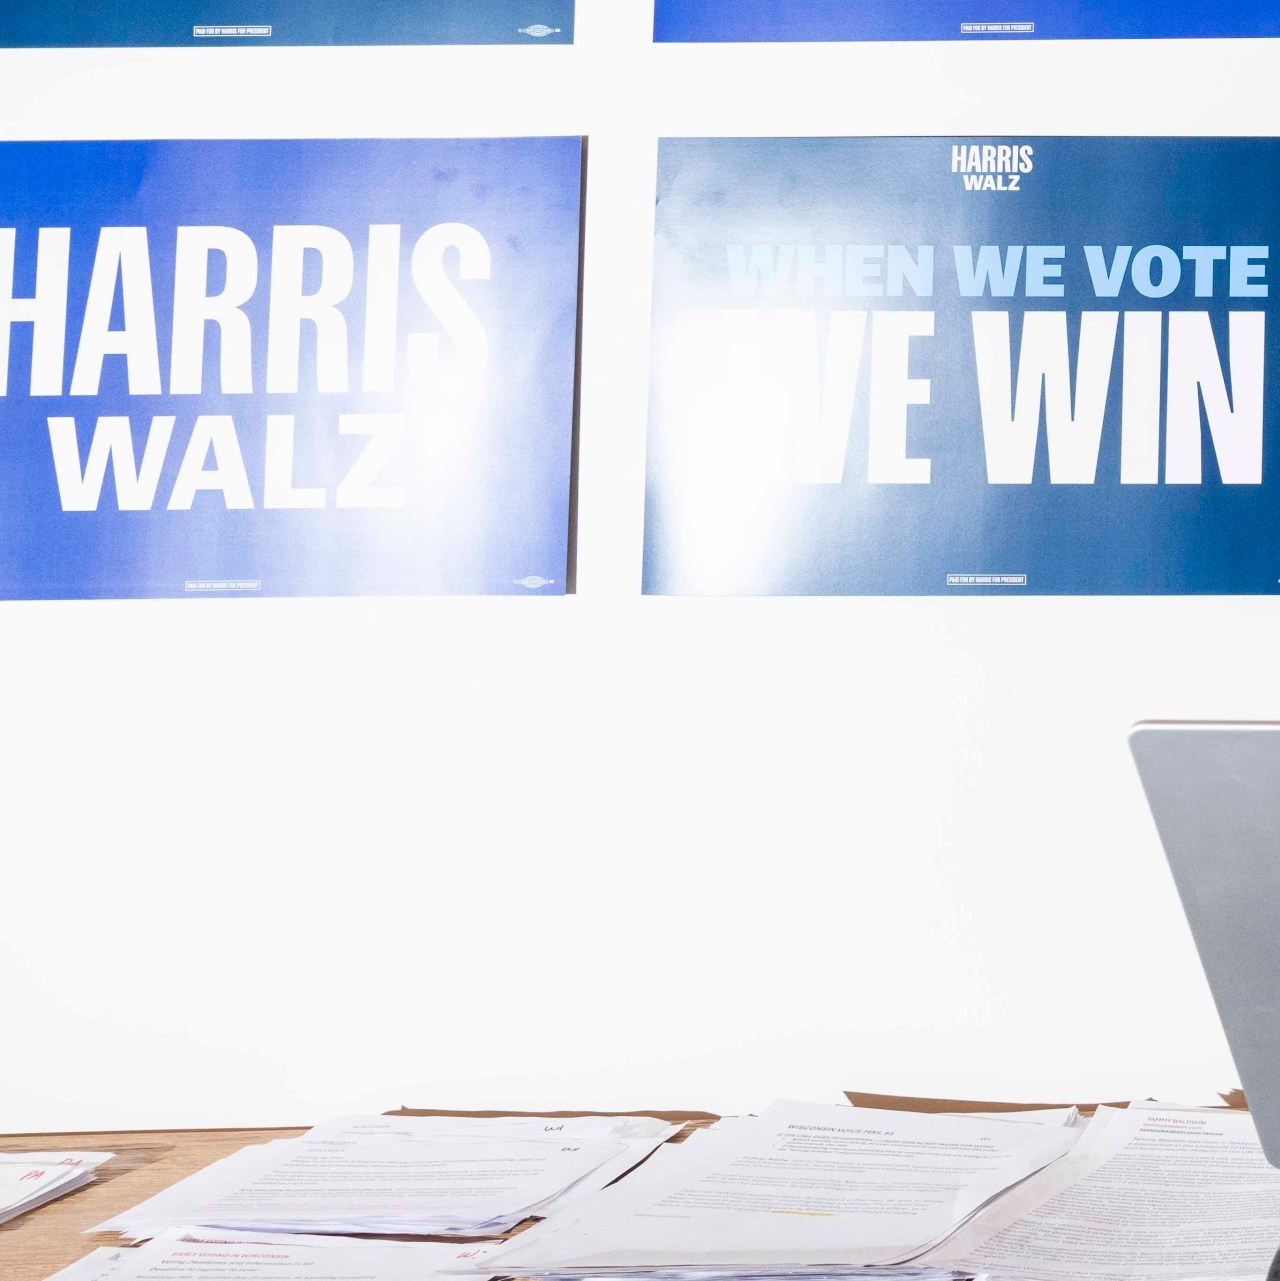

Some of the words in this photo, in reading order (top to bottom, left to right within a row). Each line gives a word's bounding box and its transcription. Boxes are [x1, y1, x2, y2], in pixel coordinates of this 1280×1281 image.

[951, 145, 1033, 173] HARRIS
[963, 175, 1020, 191] WALZ
[0, 222, 491, 396] HARRIS
[727, 245, 934, 297] WHEN
[953, 246, 1065, 297] WE
[1084, 245, 1269, 298] VOTE
[971, 311, 1266, 484] WIN
[47, 414, 406, 511] WALZ
